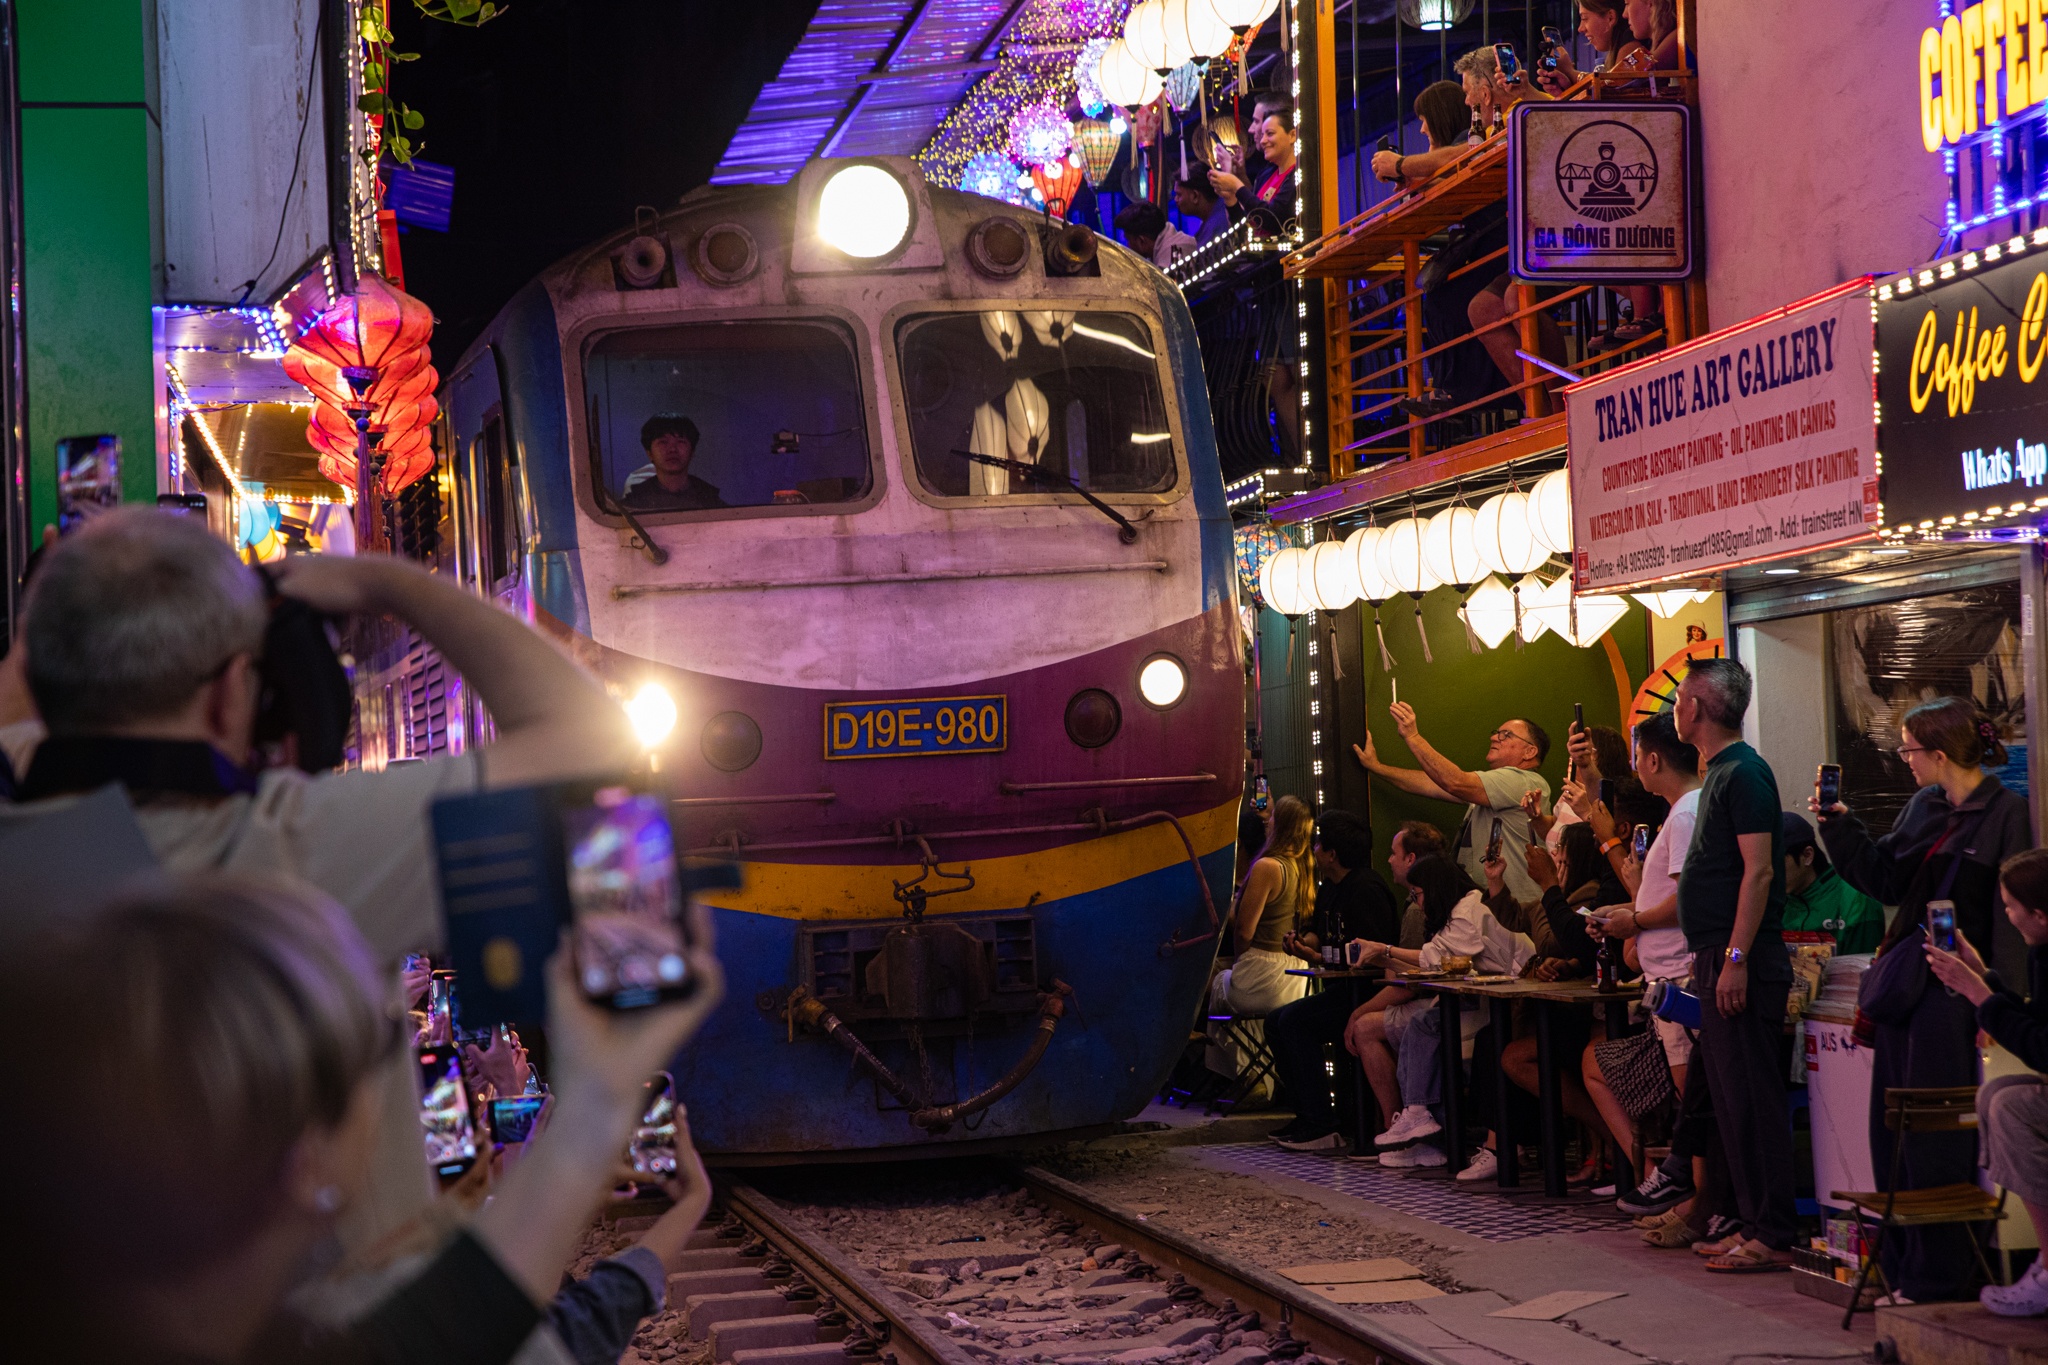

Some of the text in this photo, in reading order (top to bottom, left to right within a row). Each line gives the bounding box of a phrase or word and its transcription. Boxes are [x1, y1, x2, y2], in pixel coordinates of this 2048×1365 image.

[1534, 223, 1675, 249] GA ĐÔNG DƯƠNG
[1595, 317, 1837, 443] TRAN HUE ART GALLERY
[1909, 305, 2009, 418] Coffee
[1602, 455, 1649, 492] COUNTRYSIDE
[1650, 443, 1686, 479] ABSTRACT
[1687, 431, 1723, 468] PAINTING
[1730, 426, 1744, 456] OIL
[1745, 414, 1784, 452] PAINTING
[1785, 410, 1799, 441] ON
[1800, 399, 1836, 437] CANVAS
[1962, 438, 2047, 491] Whats App
[1589, 506, 1634, 541] WATERCOLOR
[1635, 503, 1646, 529] ON
[1647, 499, 1663, 527] SILK
[1668, 485, 1716, 521] TRADITIONAL
[1716, 479, 1739, 511] HAND
[1740, 464, 1792, 505] EMBROIDERY
[1795, 458, 1815, 492] SILK
[1816, 447, 1859, 486] PAINTING
[1589, 557, 1616, 581] Hotline:
[1616, 553, 1629, 575] +84
[1670, 524, 1773, 564] tranhueart1985@gmail.com
[1779, 515, 1800, 540] Add:
[1801, 504, 1847, 536] trainstreet
[1848, 499, 1863, 526] HN
[833, 704, 999, 750] D19E-980
